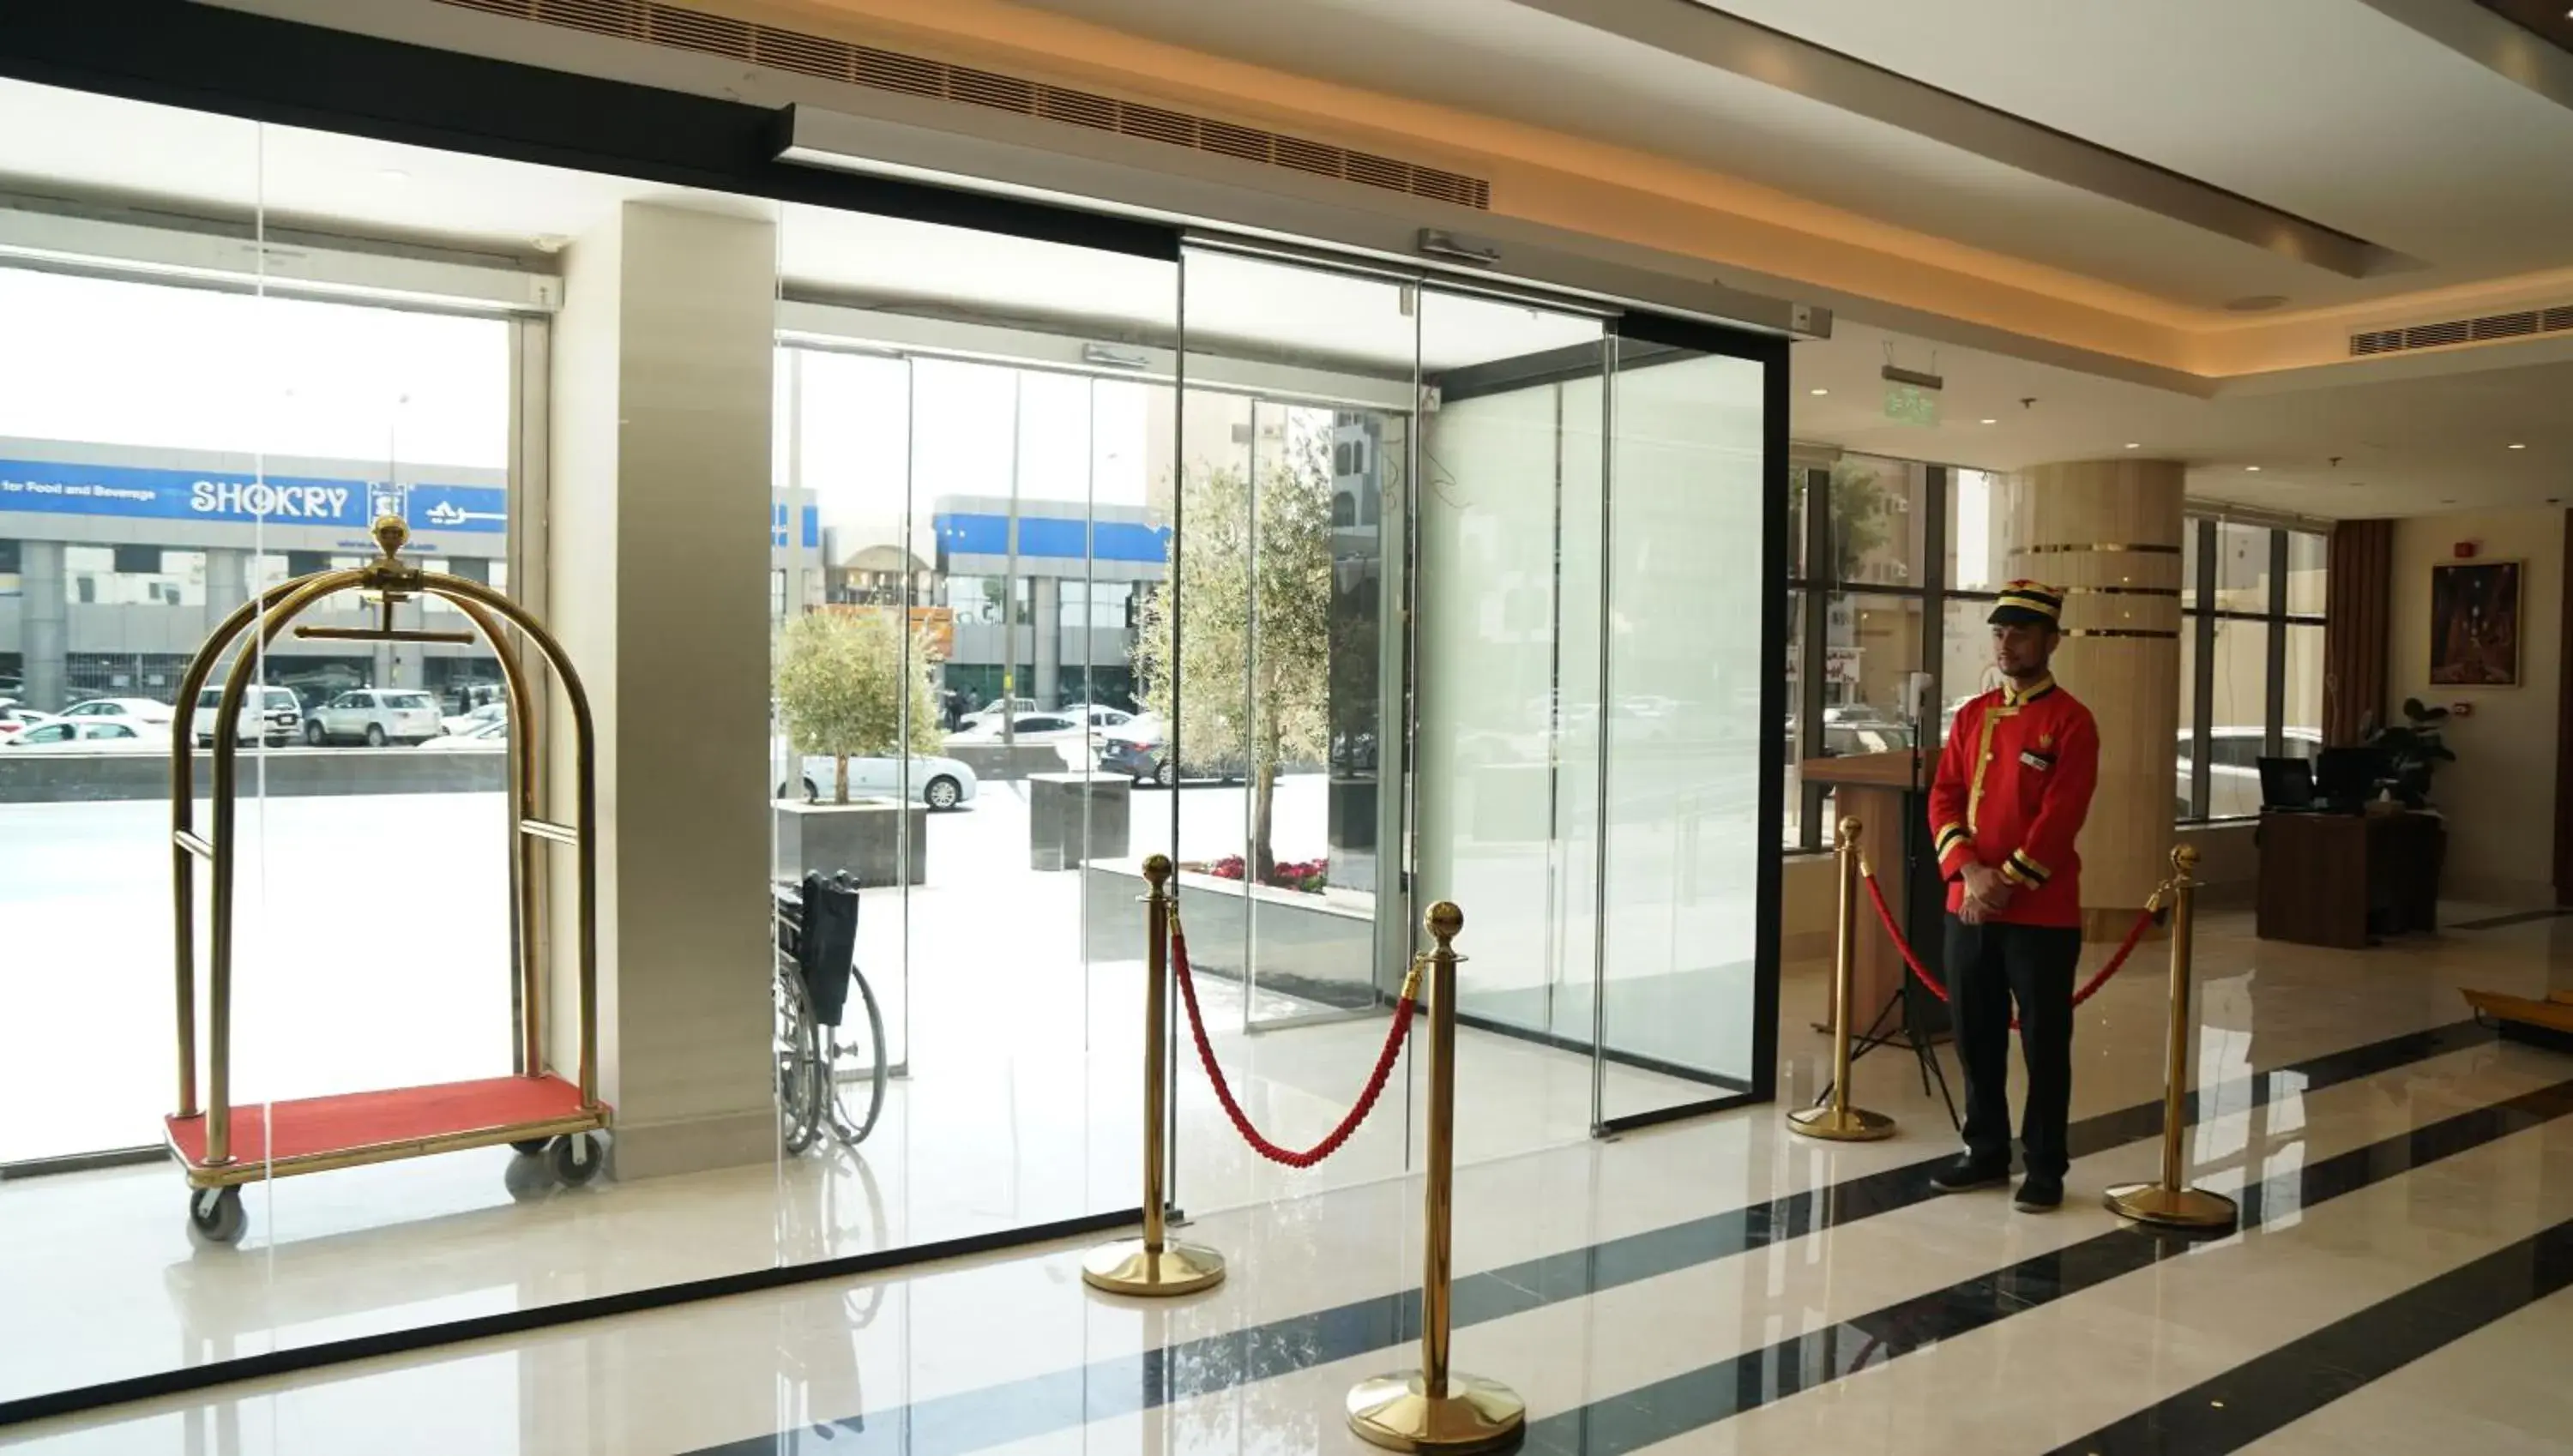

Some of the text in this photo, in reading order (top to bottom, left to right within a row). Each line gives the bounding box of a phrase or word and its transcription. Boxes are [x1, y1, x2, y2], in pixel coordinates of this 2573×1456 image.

[26, 480, 63, 495] Food
[64, 483, 92, 496] and
[93, 484, 156, 502] Beverage
[190, 480, 348, 518] SHOKRY
